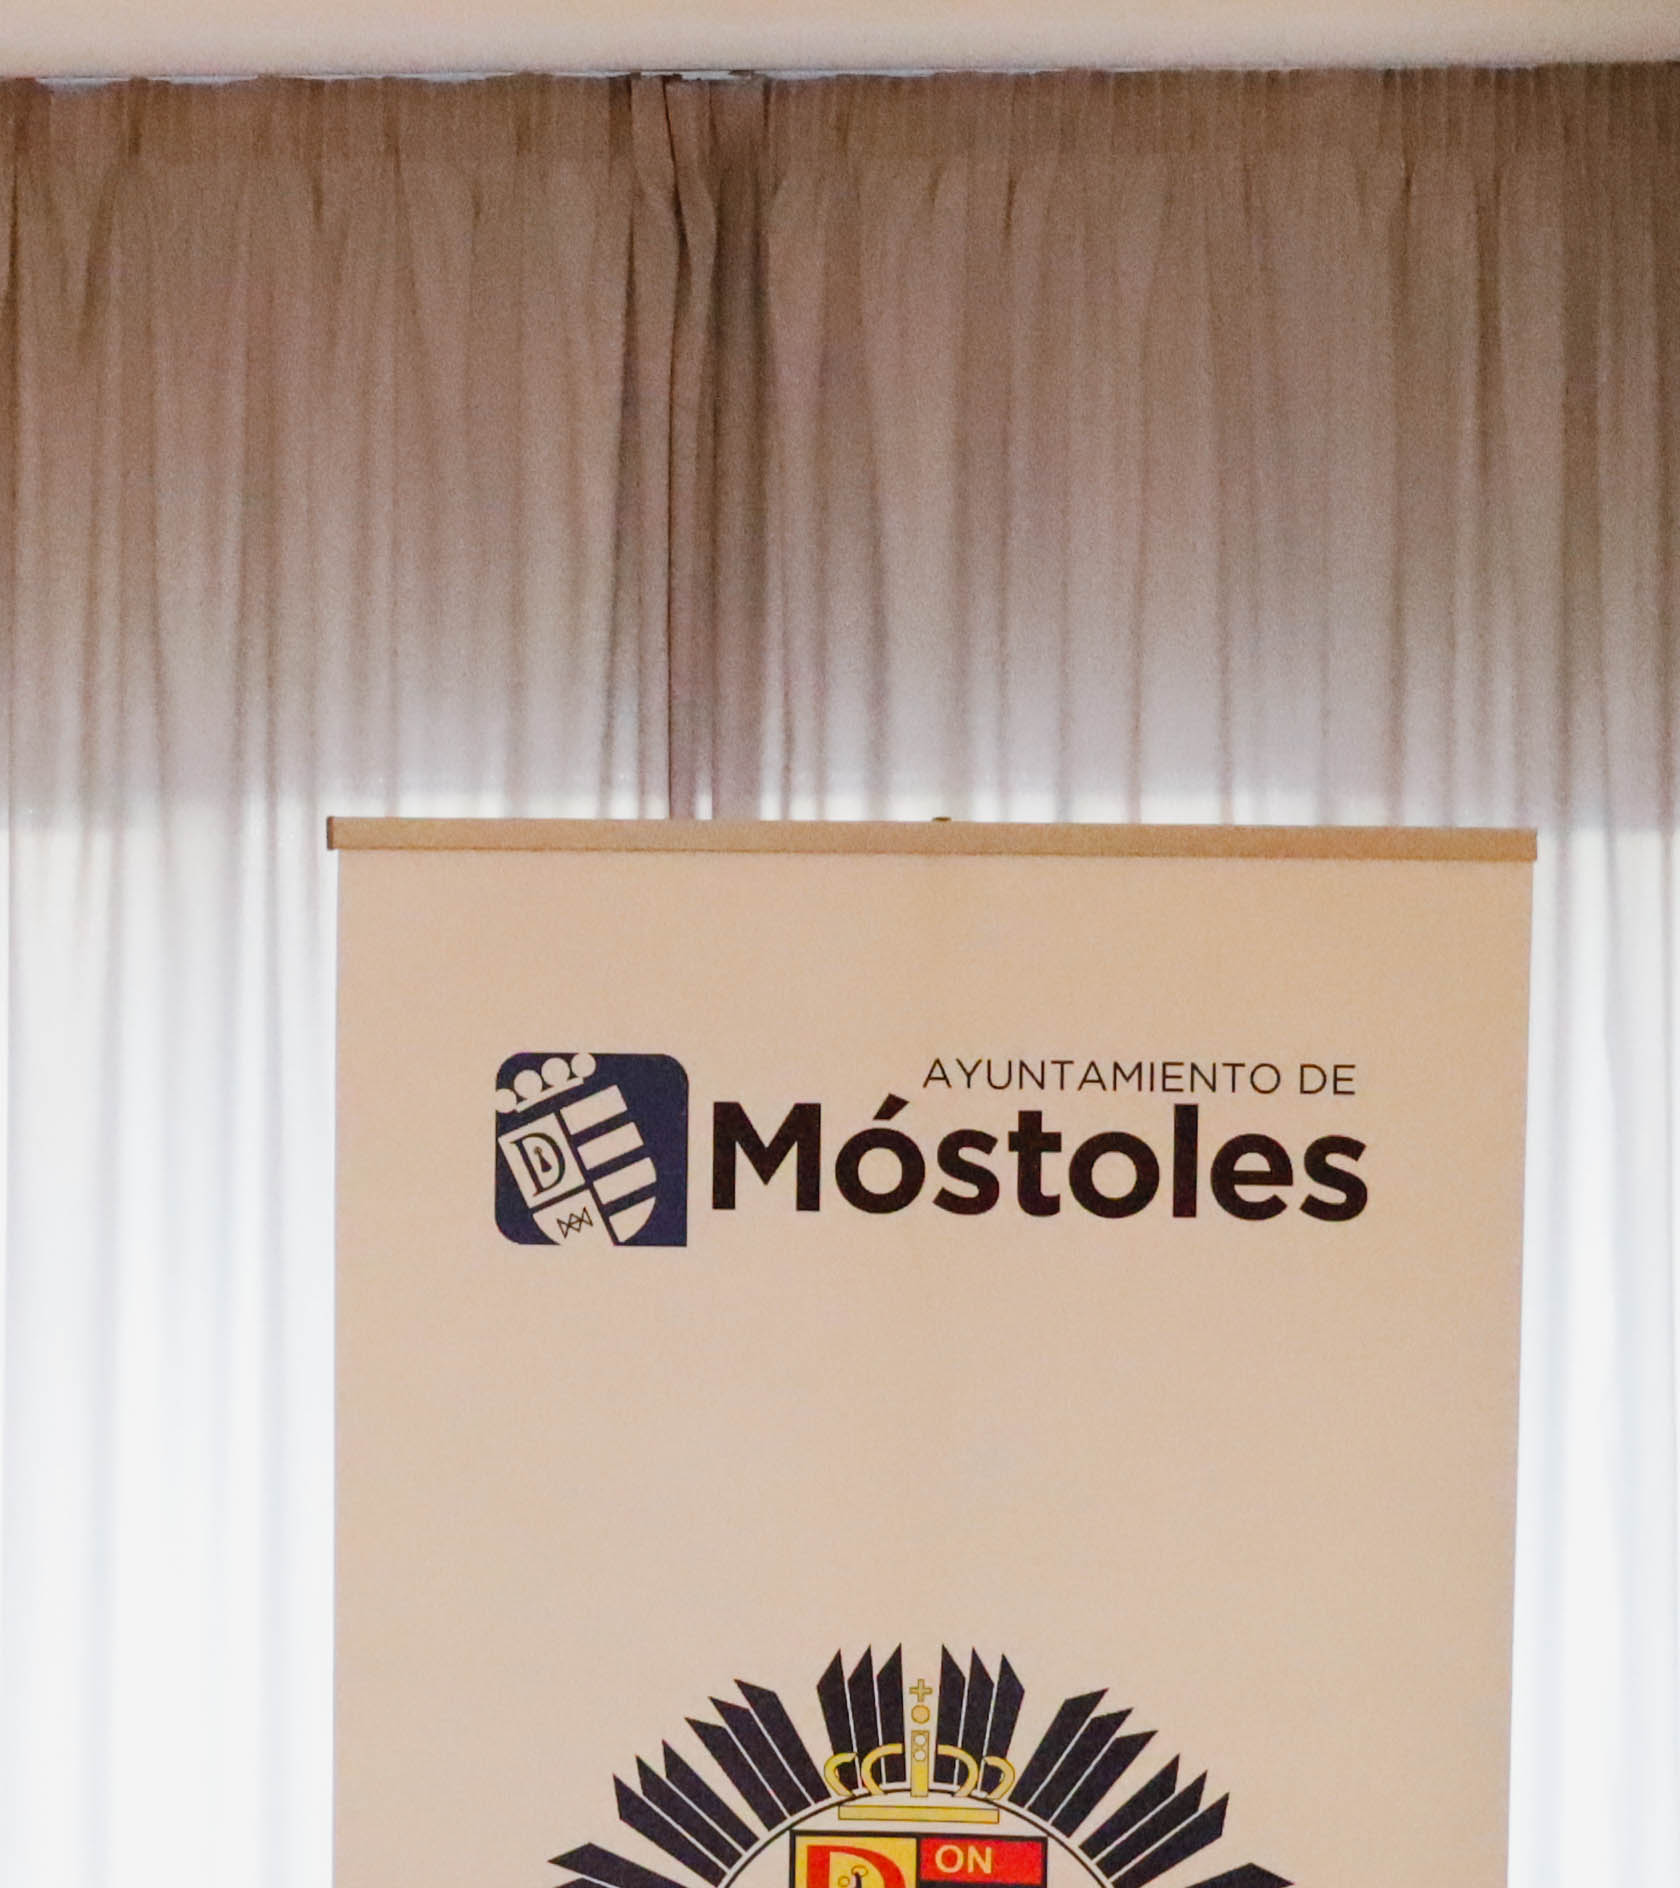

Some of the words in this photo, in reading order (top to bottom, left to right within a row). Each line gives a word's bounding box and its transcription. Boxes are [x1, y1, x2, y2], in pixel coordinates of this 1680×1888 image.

[922, 1057, 1282, 1095] AYUNTAMIENTO
[1299, 1063, 1358, 1096] DE
[712, 1093, 1369, 1223] Móstoles
[934, 1844, 993, 1875] ON
